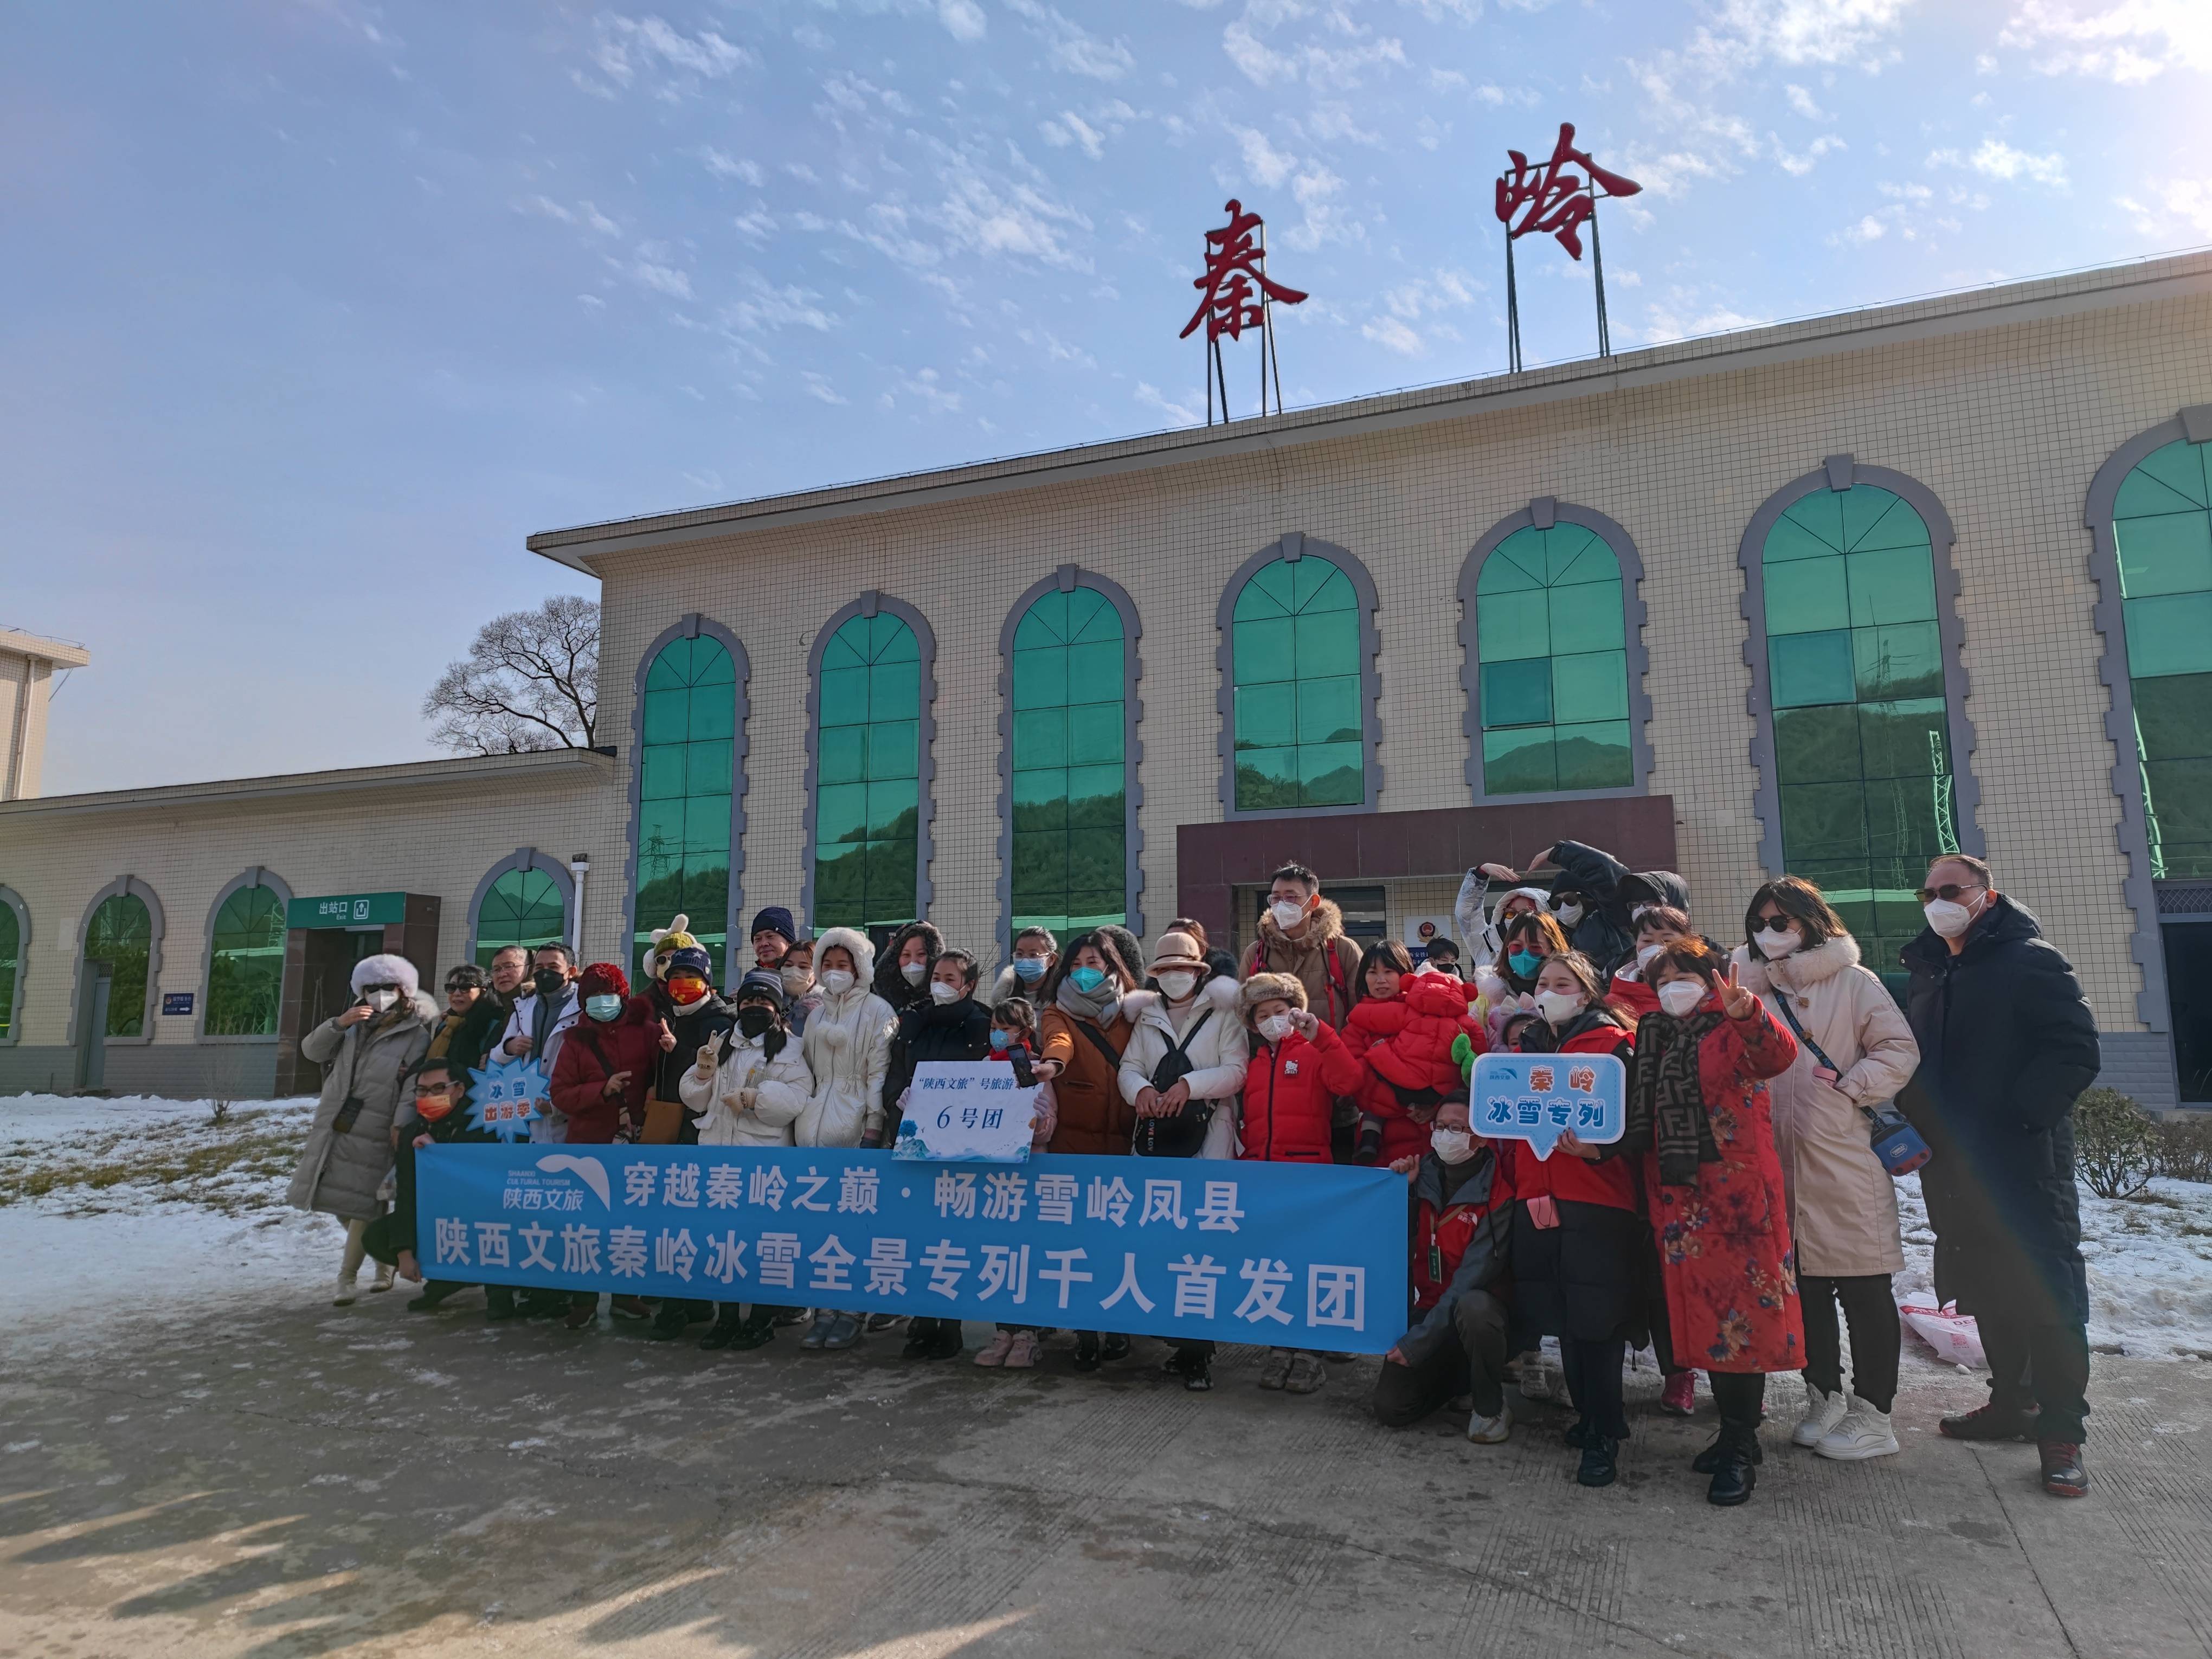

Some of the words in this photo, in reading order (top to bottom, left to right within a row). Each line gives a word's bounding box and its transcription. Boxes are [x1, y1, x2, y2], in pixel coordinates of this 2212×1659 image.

[319, 902, 348, 915] 出站口
[489, 1081, 525, 1099] 冰雪
[1531, 1066, 1595, 1093] 秦岭
[485, 1102, 530, 1121] 出游季
[1488, 1097, 1604, 1127] 冰雪专列
[506, 1178, 540, 1186] CULTURAL
[503, 1187, 584, 1212] 陕西文旅
[435, 1217, 1366, 1332] 陕西文旅秦岭冰雪全景专列千人首发团
